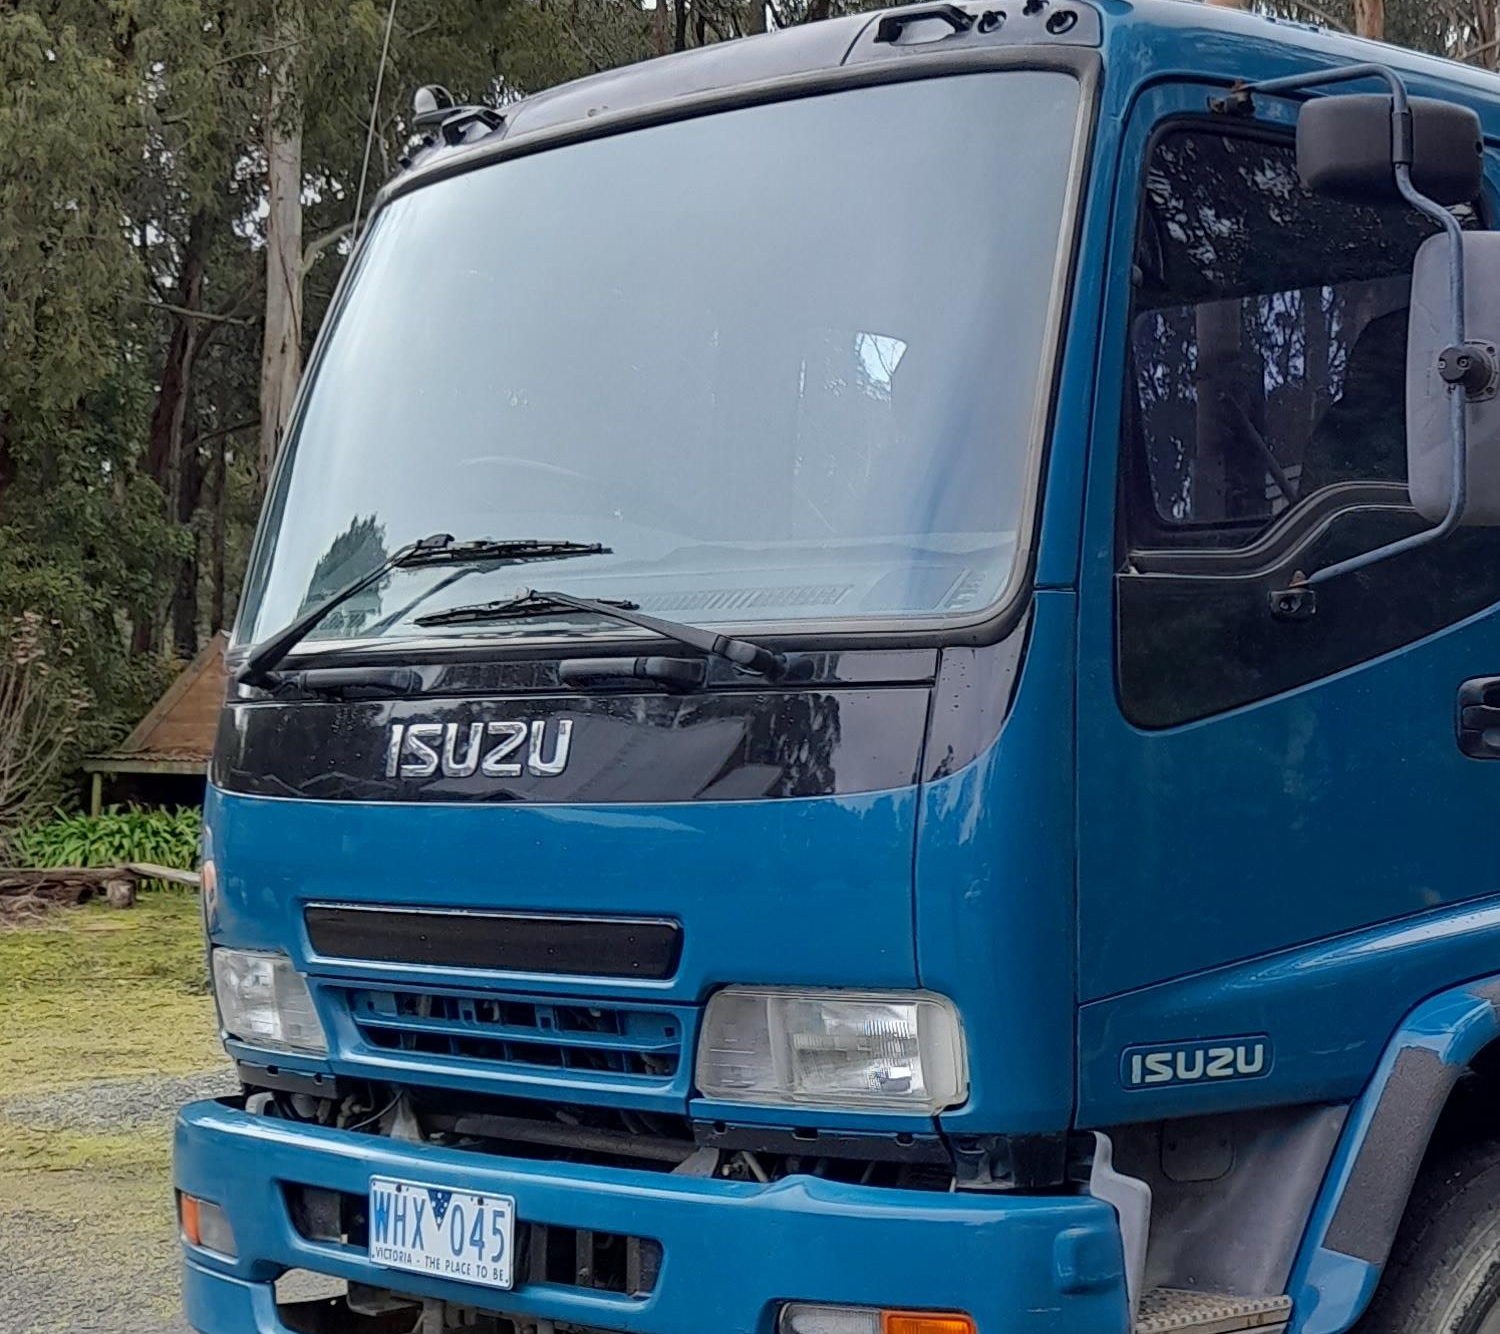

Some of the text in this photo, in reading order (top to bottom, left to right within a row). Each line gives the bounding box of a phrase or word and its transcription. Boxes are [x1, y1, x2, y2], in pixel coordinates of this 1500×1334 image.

[385, 719, 574, 778] ISUZU
[1131, 1043, 1264, 1084] ISUZU
[373, 1189, 506, 1264] WHX 045
[375, 1246, 412, 1264] VICTORIA
[424, 1255, 441, 1271] THE
[445, 1259, 471, 1276] PLACE
[476, 1265, 488, 1279] TO
[493, 1269, 504, 1282] BE
